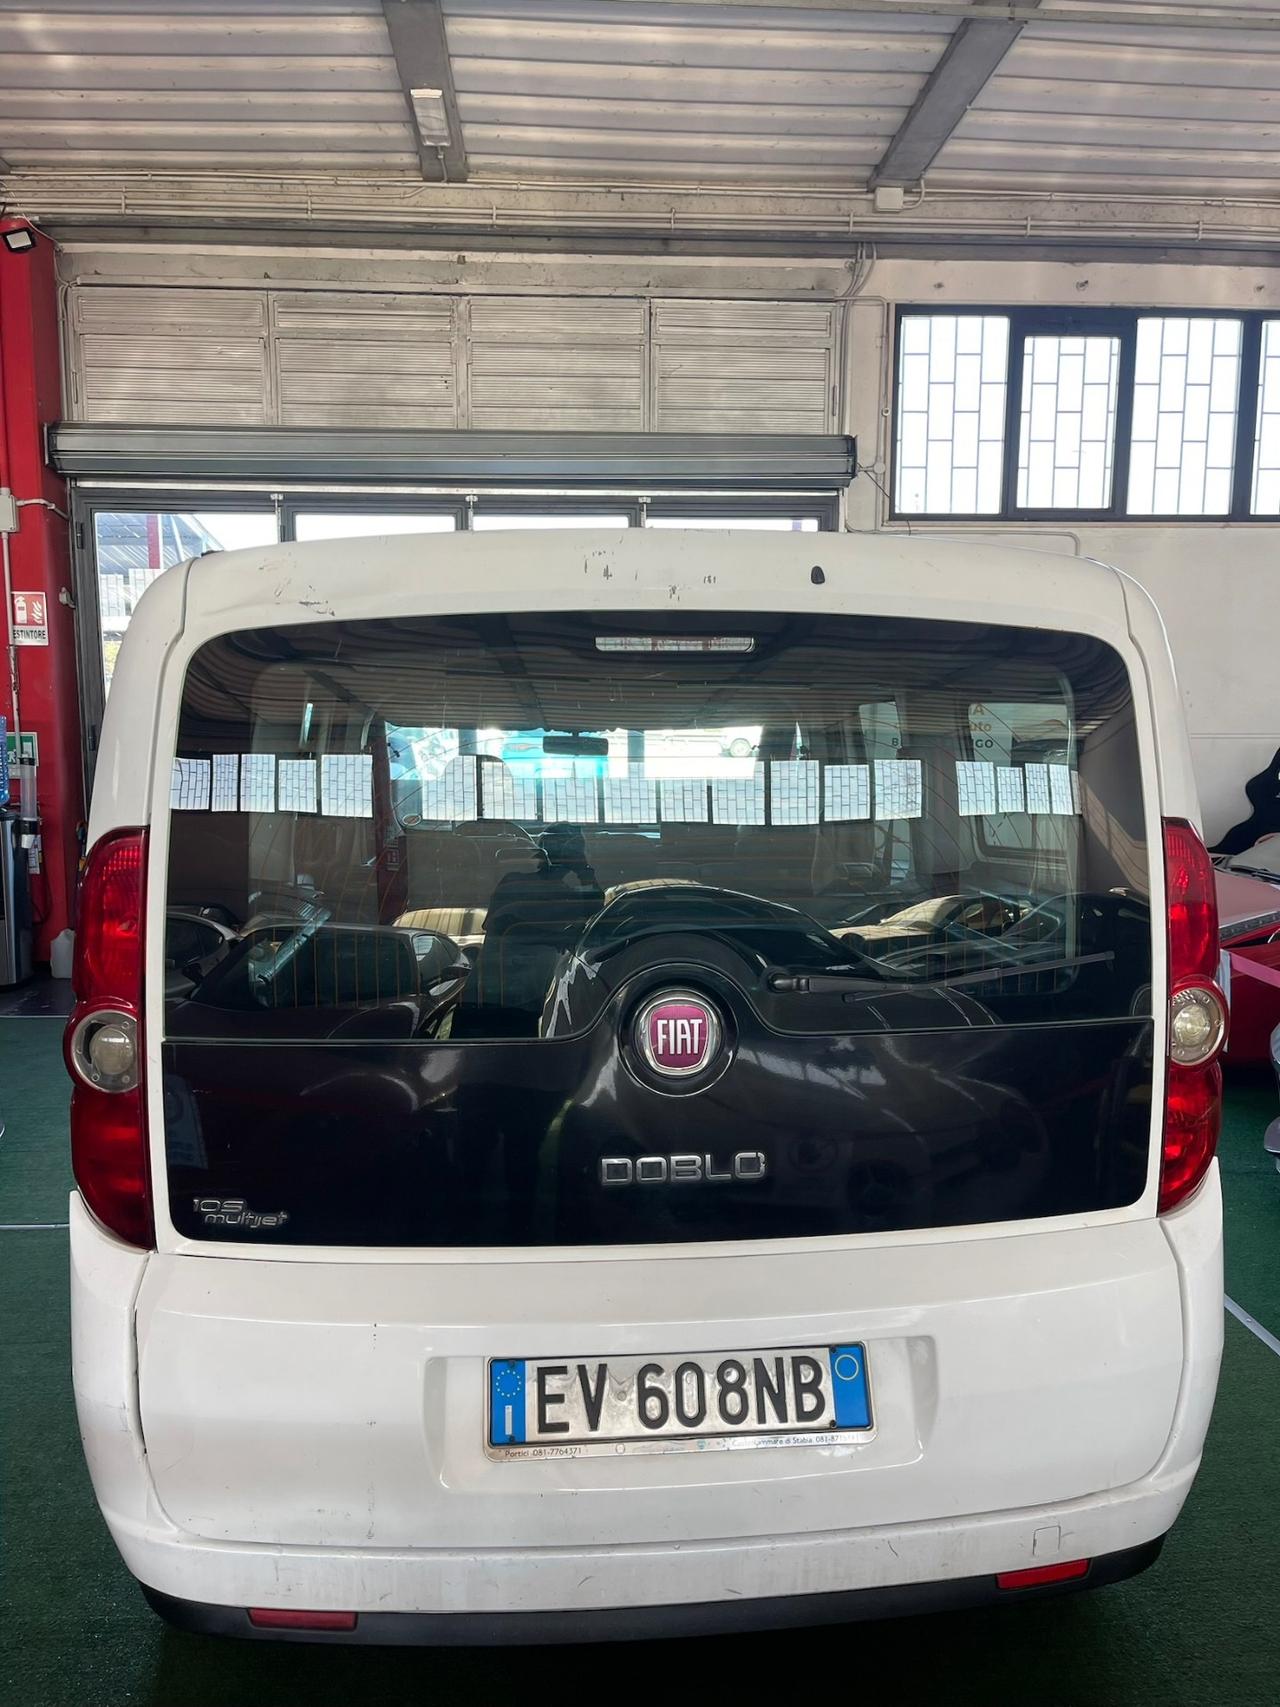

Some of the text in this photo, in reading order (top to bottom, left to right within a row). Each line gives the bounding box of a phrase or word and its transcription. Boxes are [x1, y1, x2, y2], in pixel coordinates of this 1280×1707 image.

[13, 629, 46, 640] ESTINTORE
[656, 1018, 703, 1055] FIAT
[193, 1199, 244, 1212] 105
[536, 1355, 827, 1434] EV 608NB
[504, 1447, 582, 1457] Portici 081-7764371
